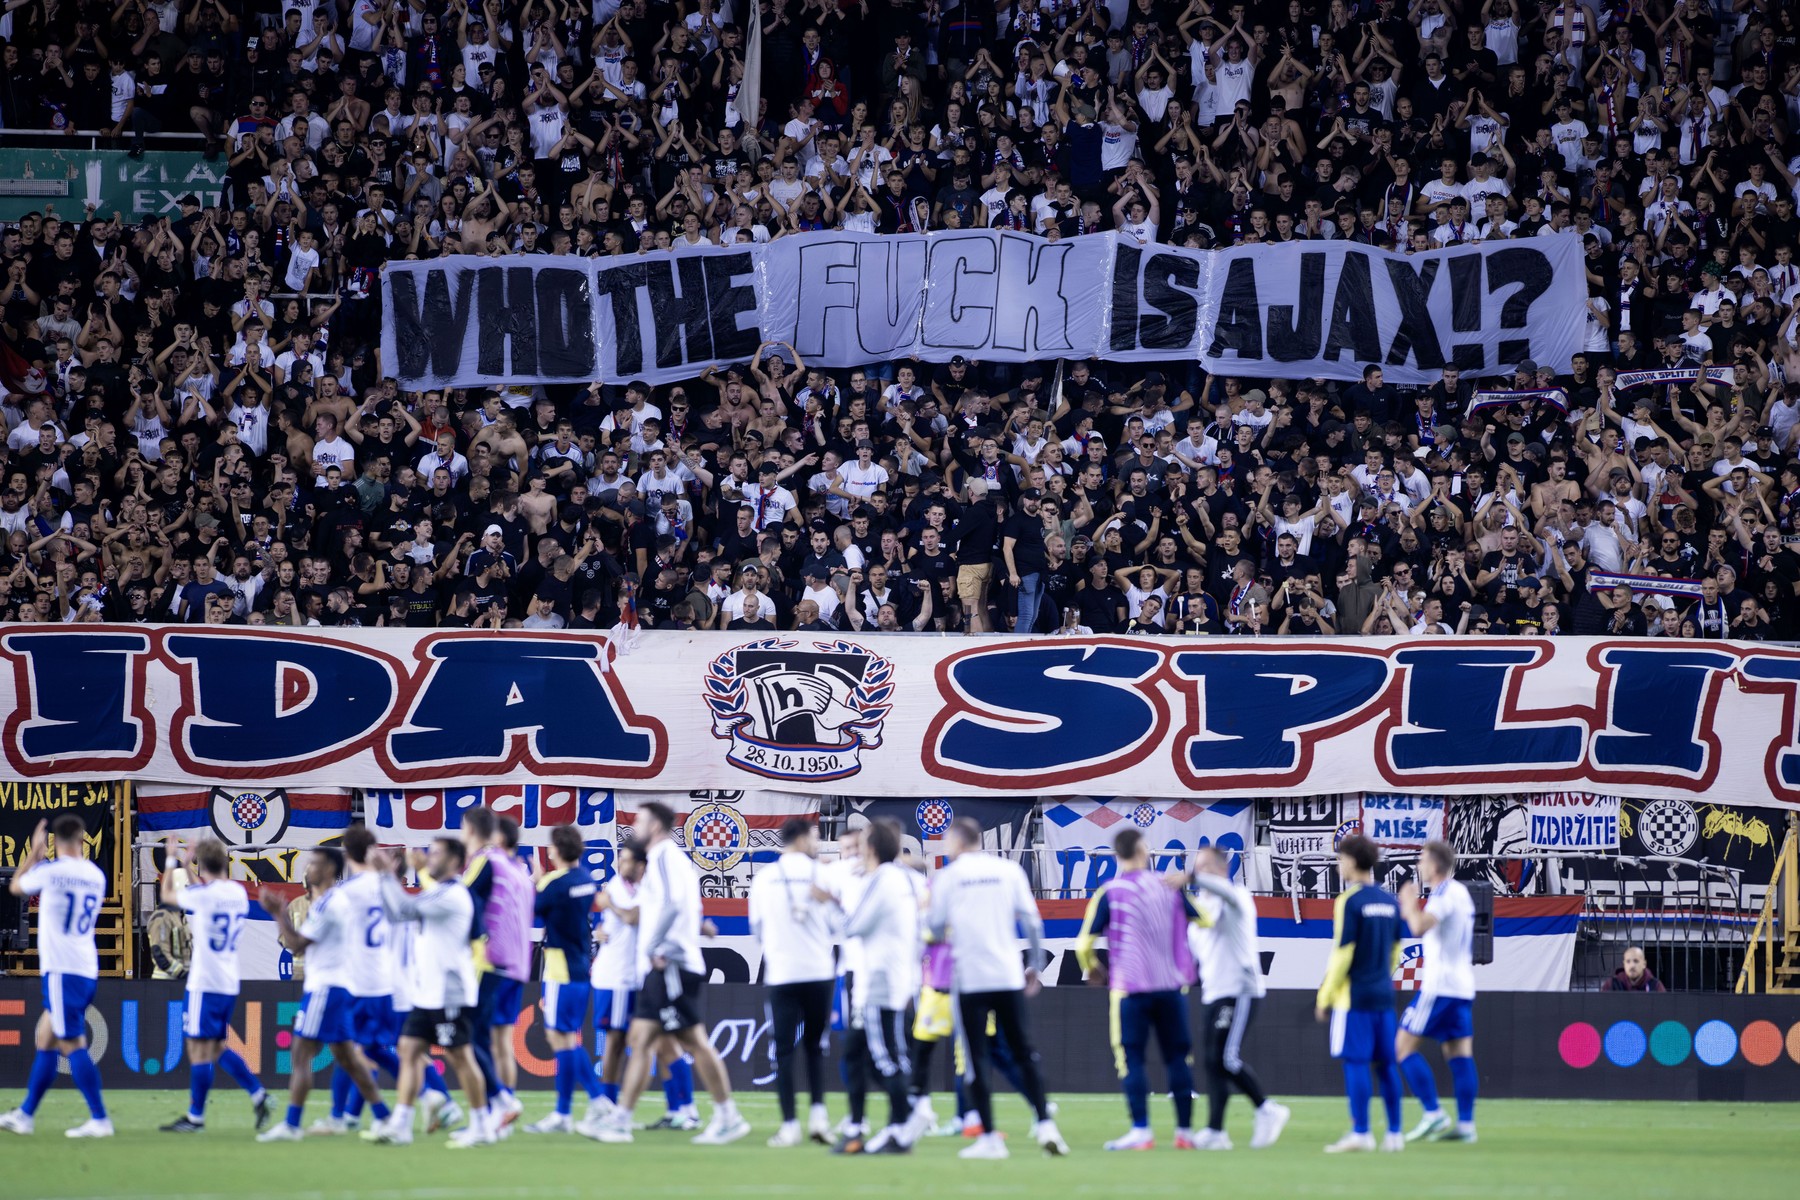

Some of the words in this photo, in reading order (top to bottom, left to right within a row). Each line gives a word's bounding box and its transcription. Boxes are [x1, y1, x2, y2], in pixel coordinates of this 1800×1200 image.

[133, 189, 221, 213] EXIT
[388, 266, 594, 379] WHO
[598, 251, 762, 377] THE
[794, 234, 1074, 357] FUCK
[1110, 242, 1199, 351] IS
[1207, 247, 1553, 370] AJAX!?
[1659, 370, 1685, 379] SPLIT
[1689, 369, 1725, 379] URAS
[234, 793, 265, 806] HAJDUK
[918, 798, 950, 812] HAJDUK
[1644, 801, 1693, 819] HAJDUK
[236, 818, 261, 829] SPLIT
[696, 812, 737, 830] HAJDUK
[920, 822, 949, 834] SPLIT
[1373, 817, 1428, 839] MIŠE
[1531, 813, 1616, 845] IZDRŽITE
[1649, 841, 1687, 857] SPLIT
[64, 892, 98, 935] 18
